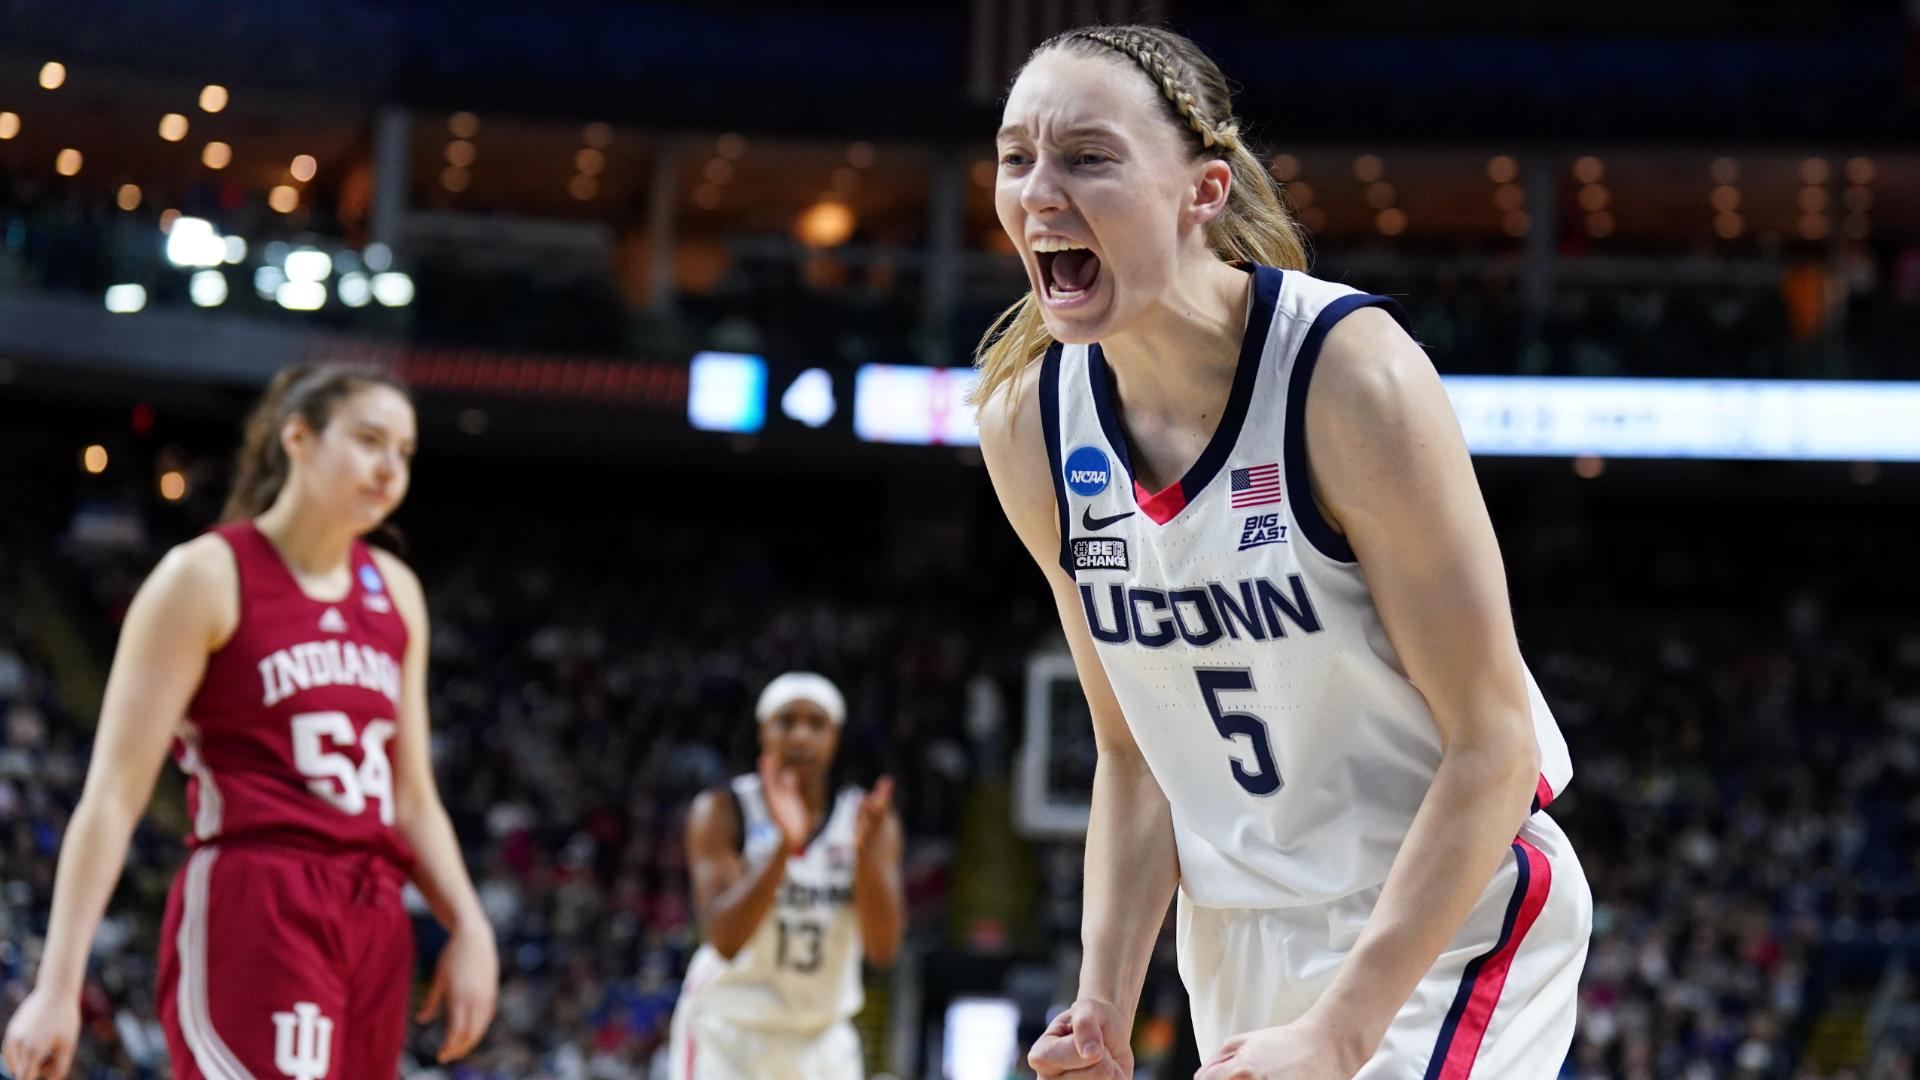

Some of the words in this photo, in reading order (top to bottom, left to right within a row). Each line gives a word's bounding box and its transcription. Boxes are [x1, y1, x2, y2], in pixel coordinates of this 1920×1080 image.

[1071, 470, 1107, 484] NCAA
[1240, 526, 1288, 544] EAST
[1244, 513, 1279, 530] BIG
[1074, 541, 1113, 556] #BE
[1077, 555, 1127, 567] CHANGE
[1080, 572, 1324, 648] UCONN
[258, 639, 399, 707] INDIAN
[1193, 666, 1284, 798] 5
[290, 711, 396, 826] 54
[775, 918, 823, 974] 13
